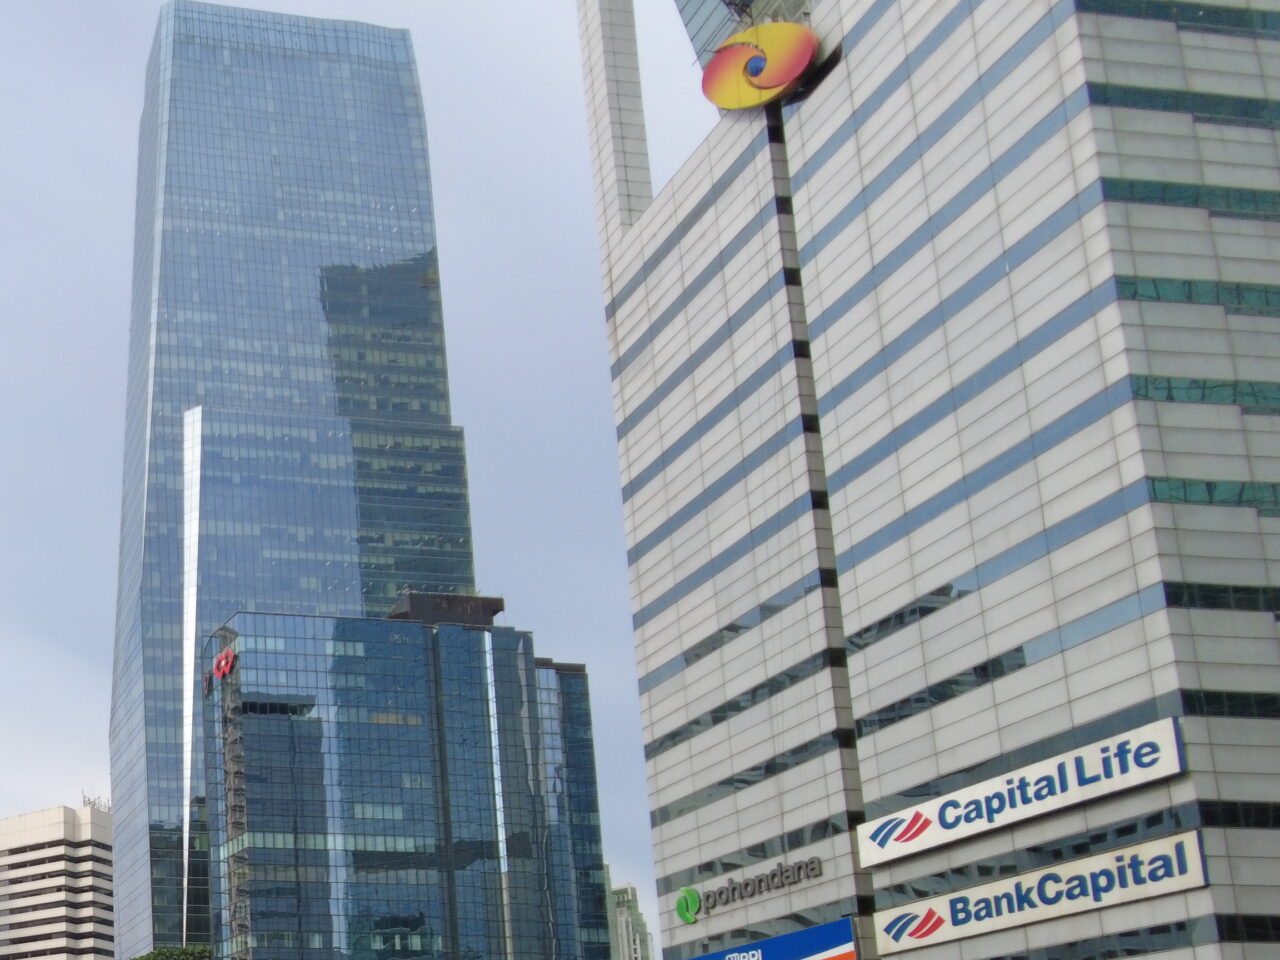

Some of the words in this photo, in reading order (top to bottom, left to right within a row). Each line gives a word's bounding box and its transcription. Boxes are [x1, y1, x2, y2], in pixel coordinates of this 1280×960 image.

[938, 761, 1069, 830] Capital
[1074, 739, 1161, 787] Life
[702, 856, 823, 914] pohondana
